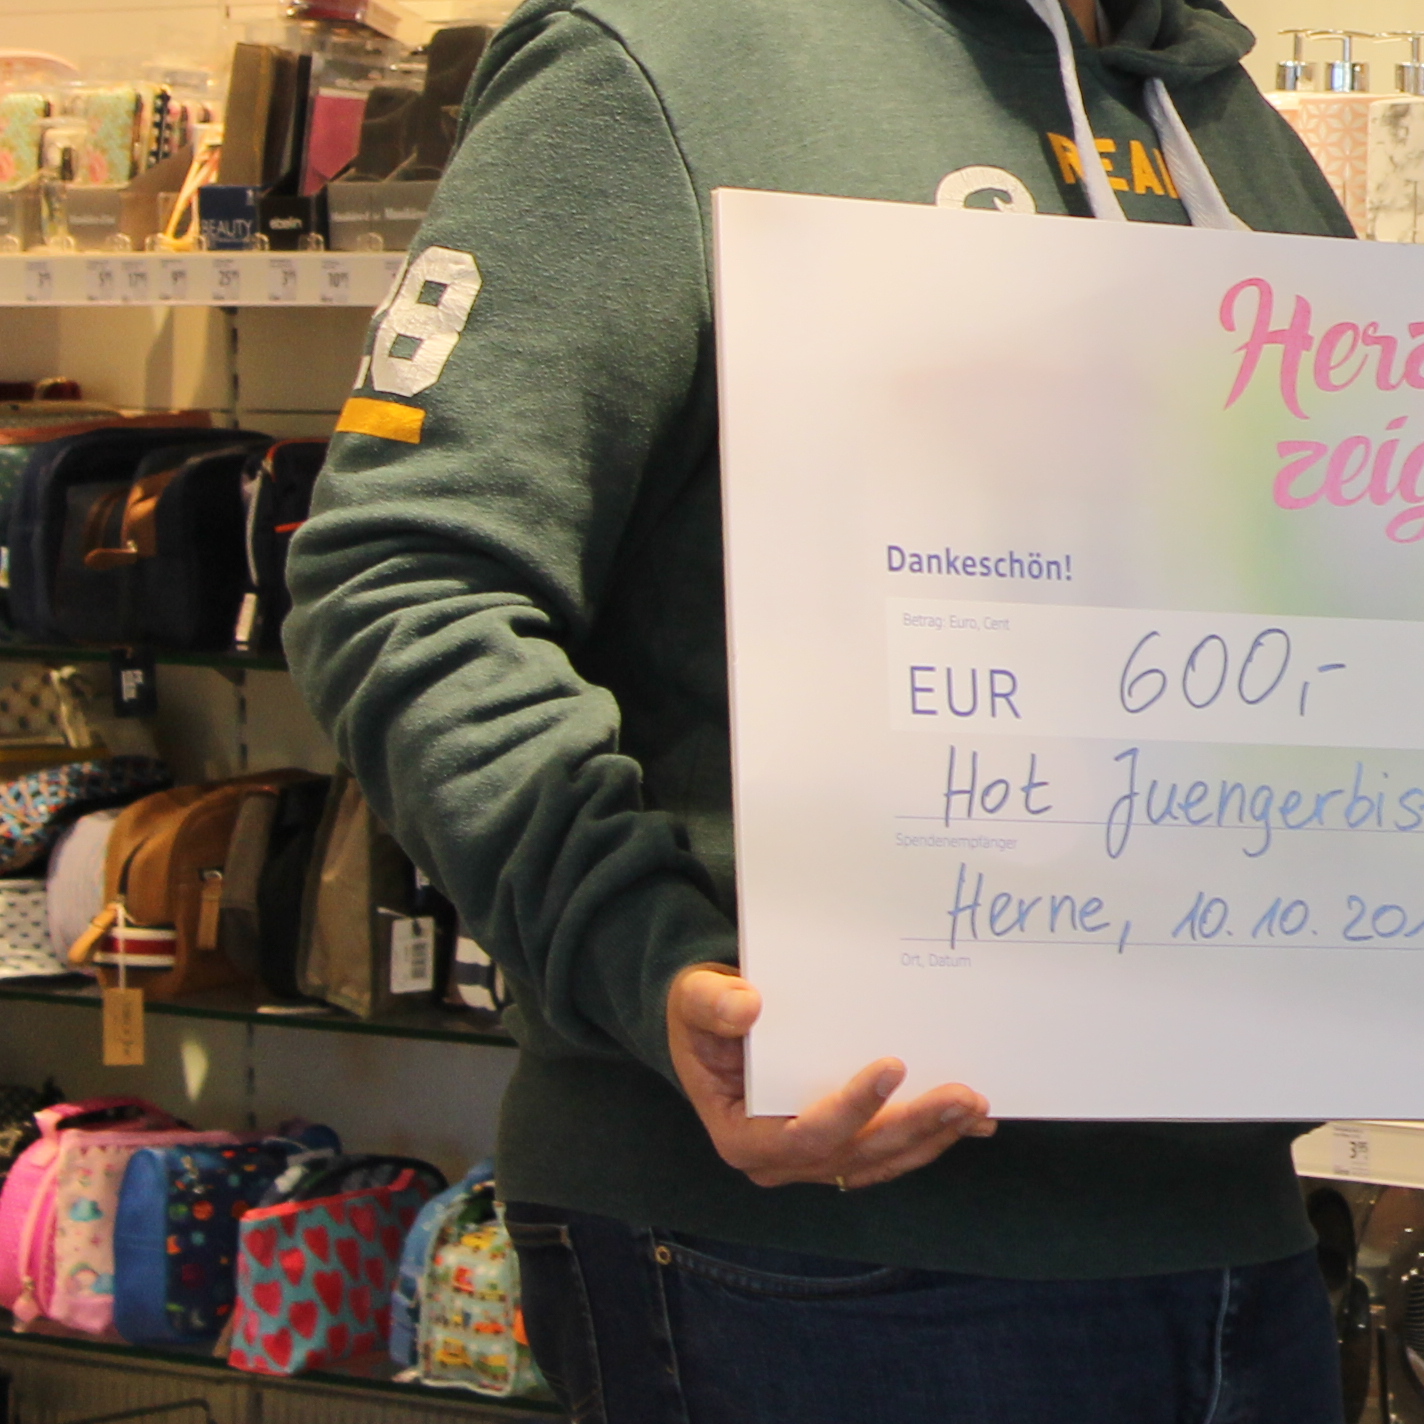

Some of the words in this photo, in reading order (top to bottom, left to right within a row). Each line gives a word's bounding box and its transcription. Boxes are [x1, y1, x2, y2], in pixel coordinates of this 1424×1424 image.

[353, 245, 482, 397] 8
[886, 544, 1073, 581] Dankeschön!
[908, 664, 1022, 719] EUR
[944, 744, 1053, 827] Hot
[947, 862, 1132, 955] Herne,
[929, 953, 972, 967] Datum
